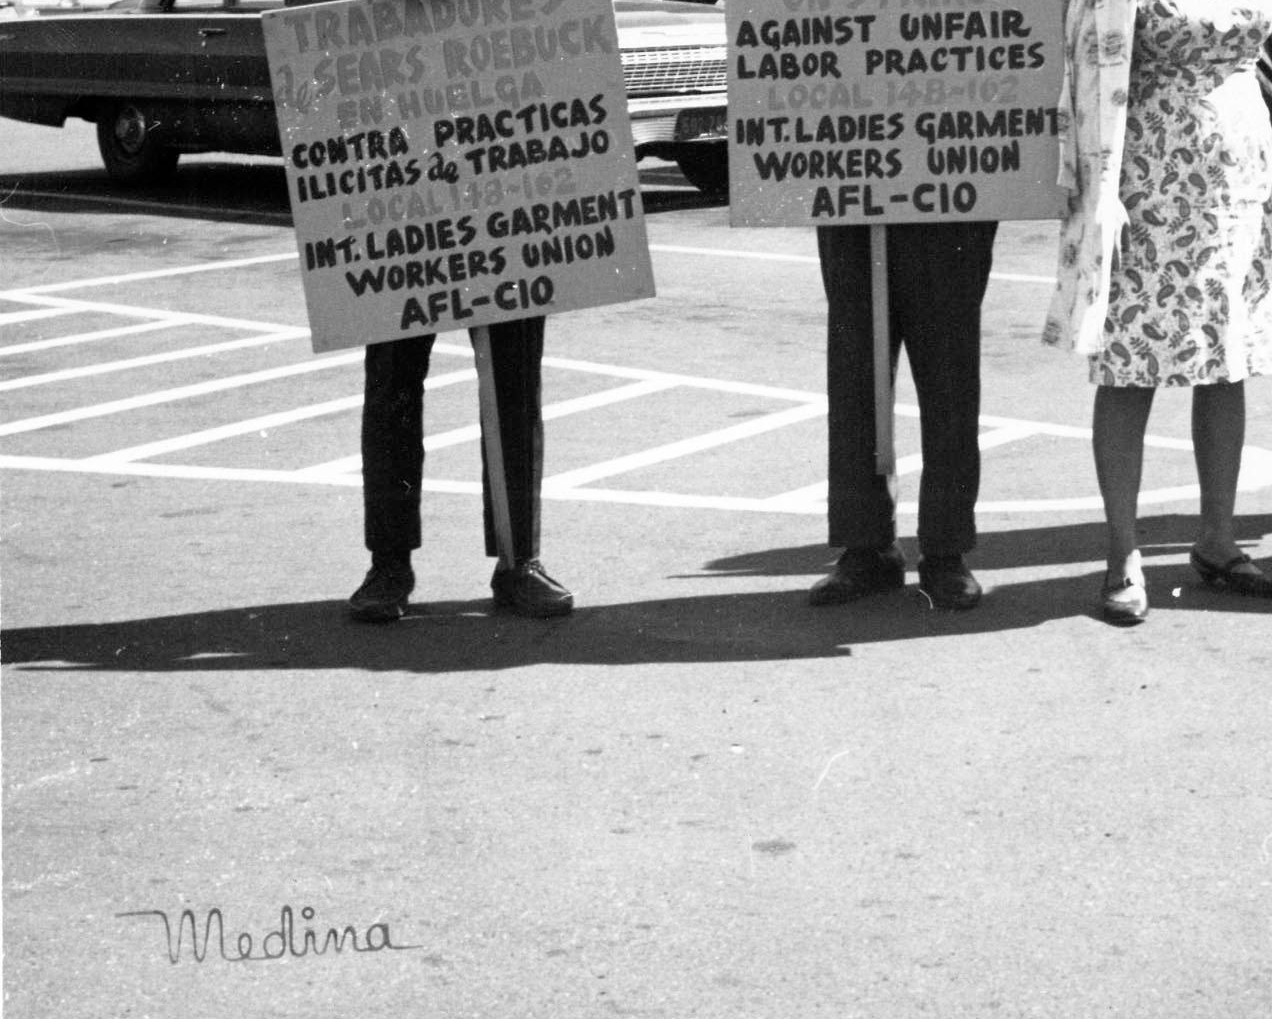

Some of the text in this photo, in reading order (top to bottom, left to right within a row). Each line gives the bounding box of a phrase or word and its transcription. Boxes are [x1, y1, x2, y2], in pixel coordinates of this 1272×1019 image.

[735, 9, 1032, 51] AGAINST UNFAIR
[313, 44, 425, 102] SEARS
[442, 15, 613, 78] ROEBUCK
[736, 41, 1045, 80] LABOR PRACTICES
[337, 70, 545, 129] EN HUELGA
[768, 82, 872, 111] LOCAL
[292, 94, 608, 170] CONTRA PRACTICAS
[736, 116, 790, 146] INT.
[795, 112, 905, 143] LADIES
[915, 107, 1059, 145] GARMENT
[298, 130, 610, 203] ILICITAS de TRABAJO
[753, 139, 1021, 182] WORKERS UNION
[342, 187, 443, 230] LOCAL
[811, 181, 977, 218] AFL-CIO
[305, 188, 636, 271] INT. LADIES GARMENT
[346, 225, 615, 297] WORKERS UNION
[401, 275, 555, 330] AFL-CIO
